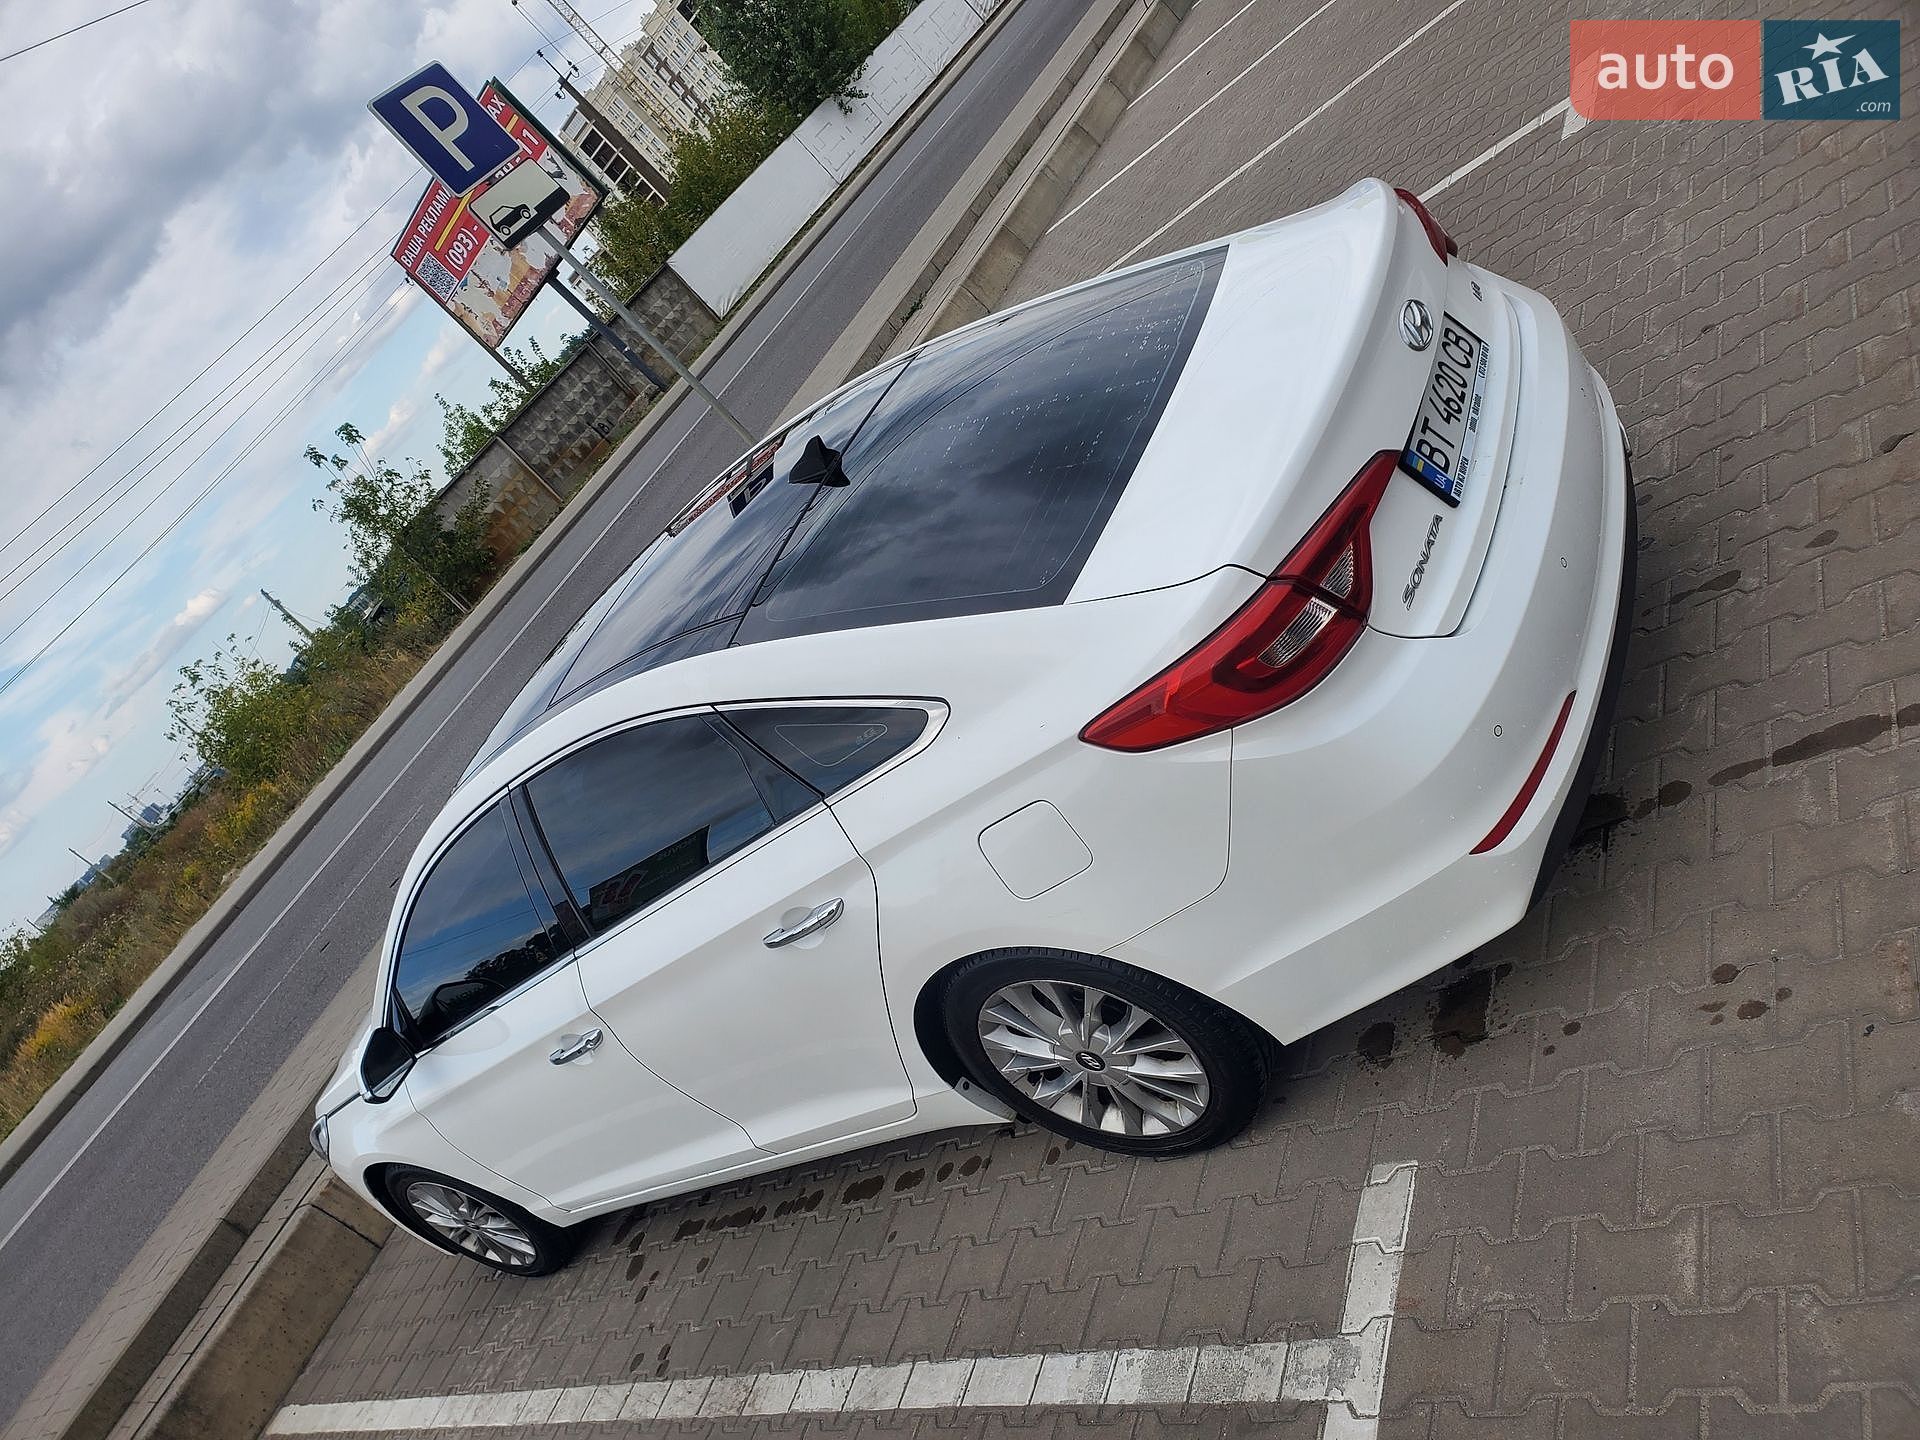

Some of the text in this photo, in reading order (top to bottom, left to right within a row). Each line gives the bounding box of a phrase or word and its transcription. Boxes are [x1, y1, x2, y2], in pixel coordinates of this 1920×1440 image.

[400, 85, 475, 172] P
[400, 234, 426, 268] ВАША
[1416, 327, 1474, 474] BT 4620 CB
[1434, 473, 1448, 489] UA
[1402, 513, 1443, 611] SONATA
